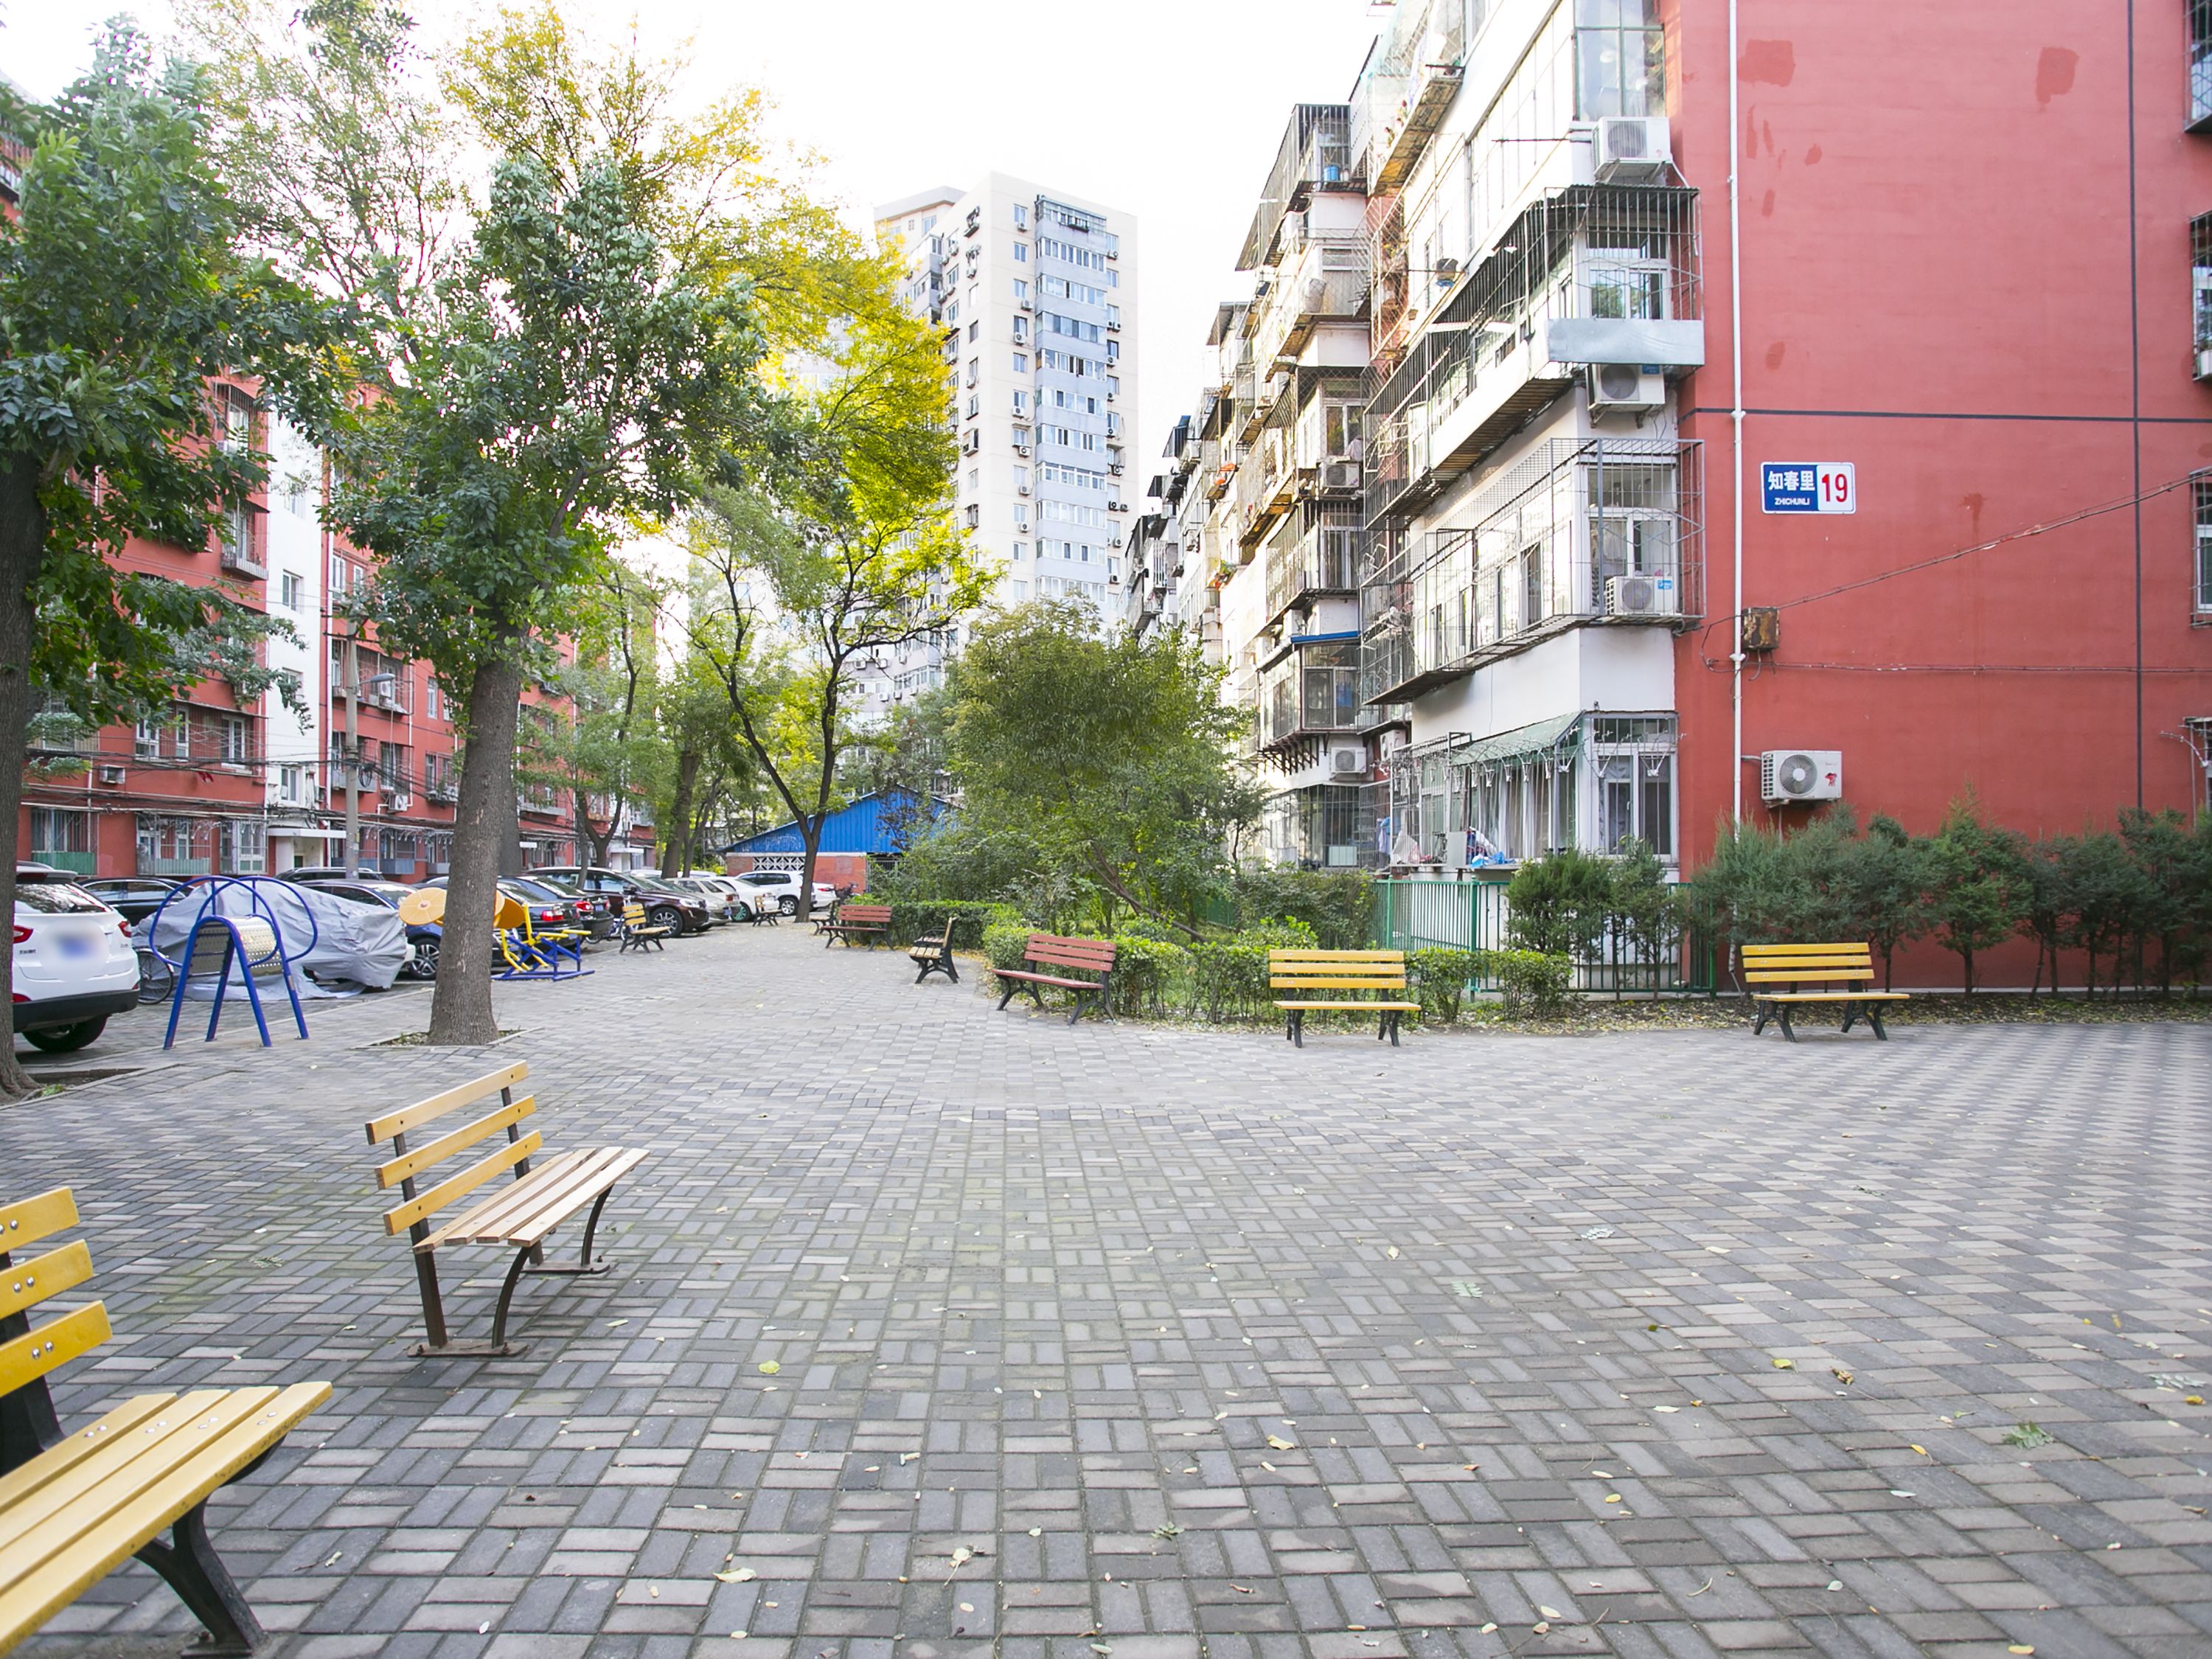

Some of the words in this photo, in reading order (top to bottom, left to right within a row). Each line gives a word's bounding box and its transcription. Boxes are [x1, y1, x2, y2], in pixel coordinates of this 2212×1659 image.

[1768, 470, 1815, 491] 知春里
[1821, 473, 1848, 502] 19
[1774, 497, 1810, 506] ZHICHUNLI
